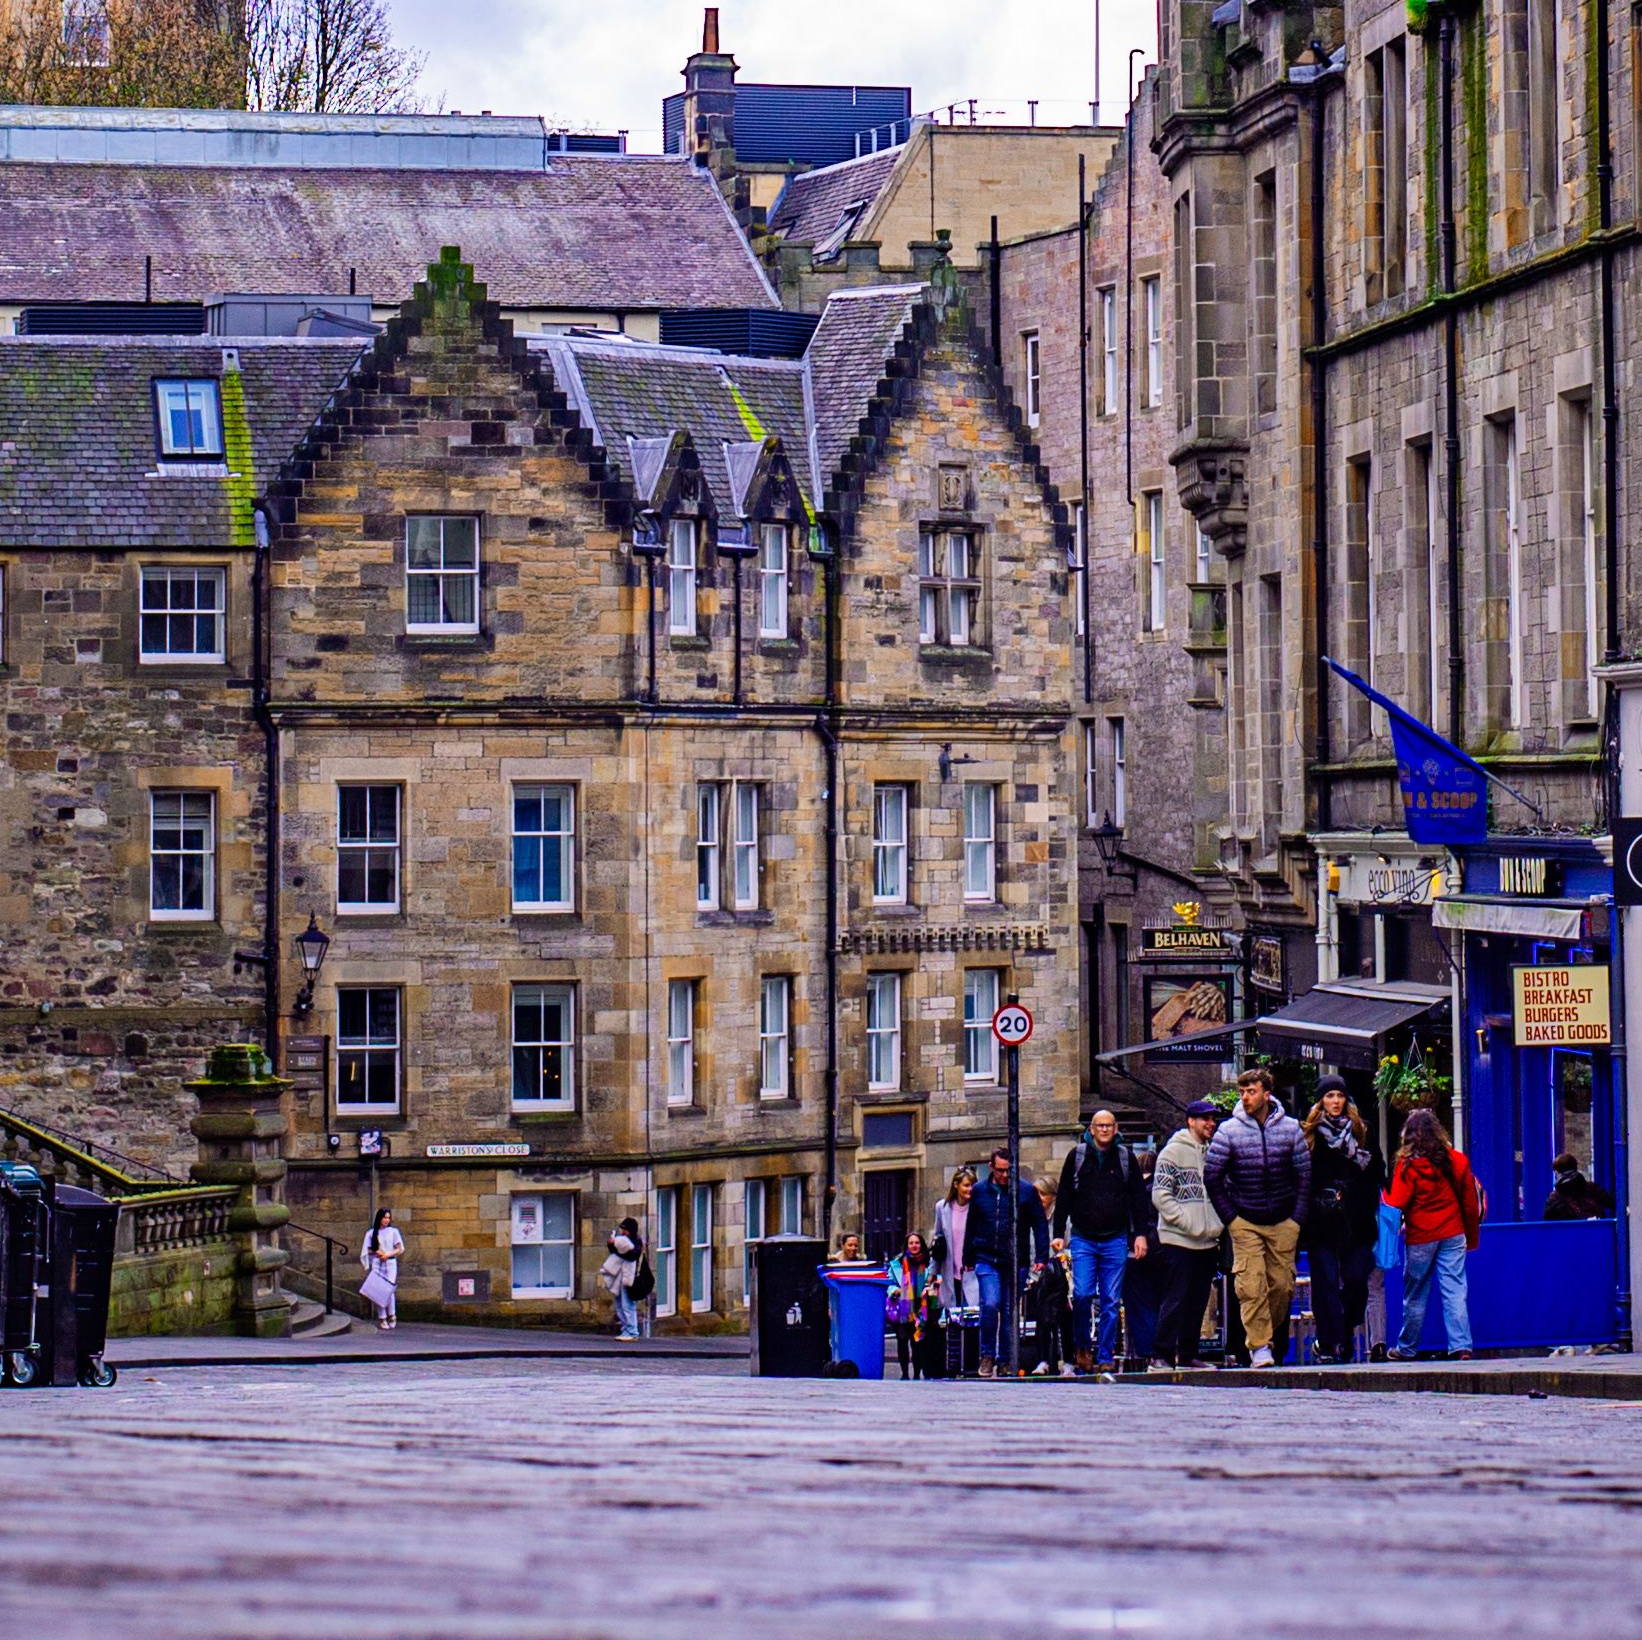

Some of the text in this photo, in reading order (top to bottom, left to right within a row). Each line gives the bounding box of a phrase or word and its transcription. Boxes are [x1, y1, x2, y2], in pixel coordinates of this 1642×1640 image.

[1431, 791, 1478, 809] SCOOP
[1154, 931, 1221, 948] BELHAVEN
[1523, 971, 1569, 987] BISTRO
[1524, 989, 1593, 1005] BREAKFAST
[1525, 1007, 1579, 1023] BURGERS
[1000, 1016, 1027, 1033] 20
[1526, 1024, 1608, 1041] BAKED GOODS
[1193, 1044, 1223, 1052] SHOVEL
[495, 1145, 525, 1155] CLOSE
